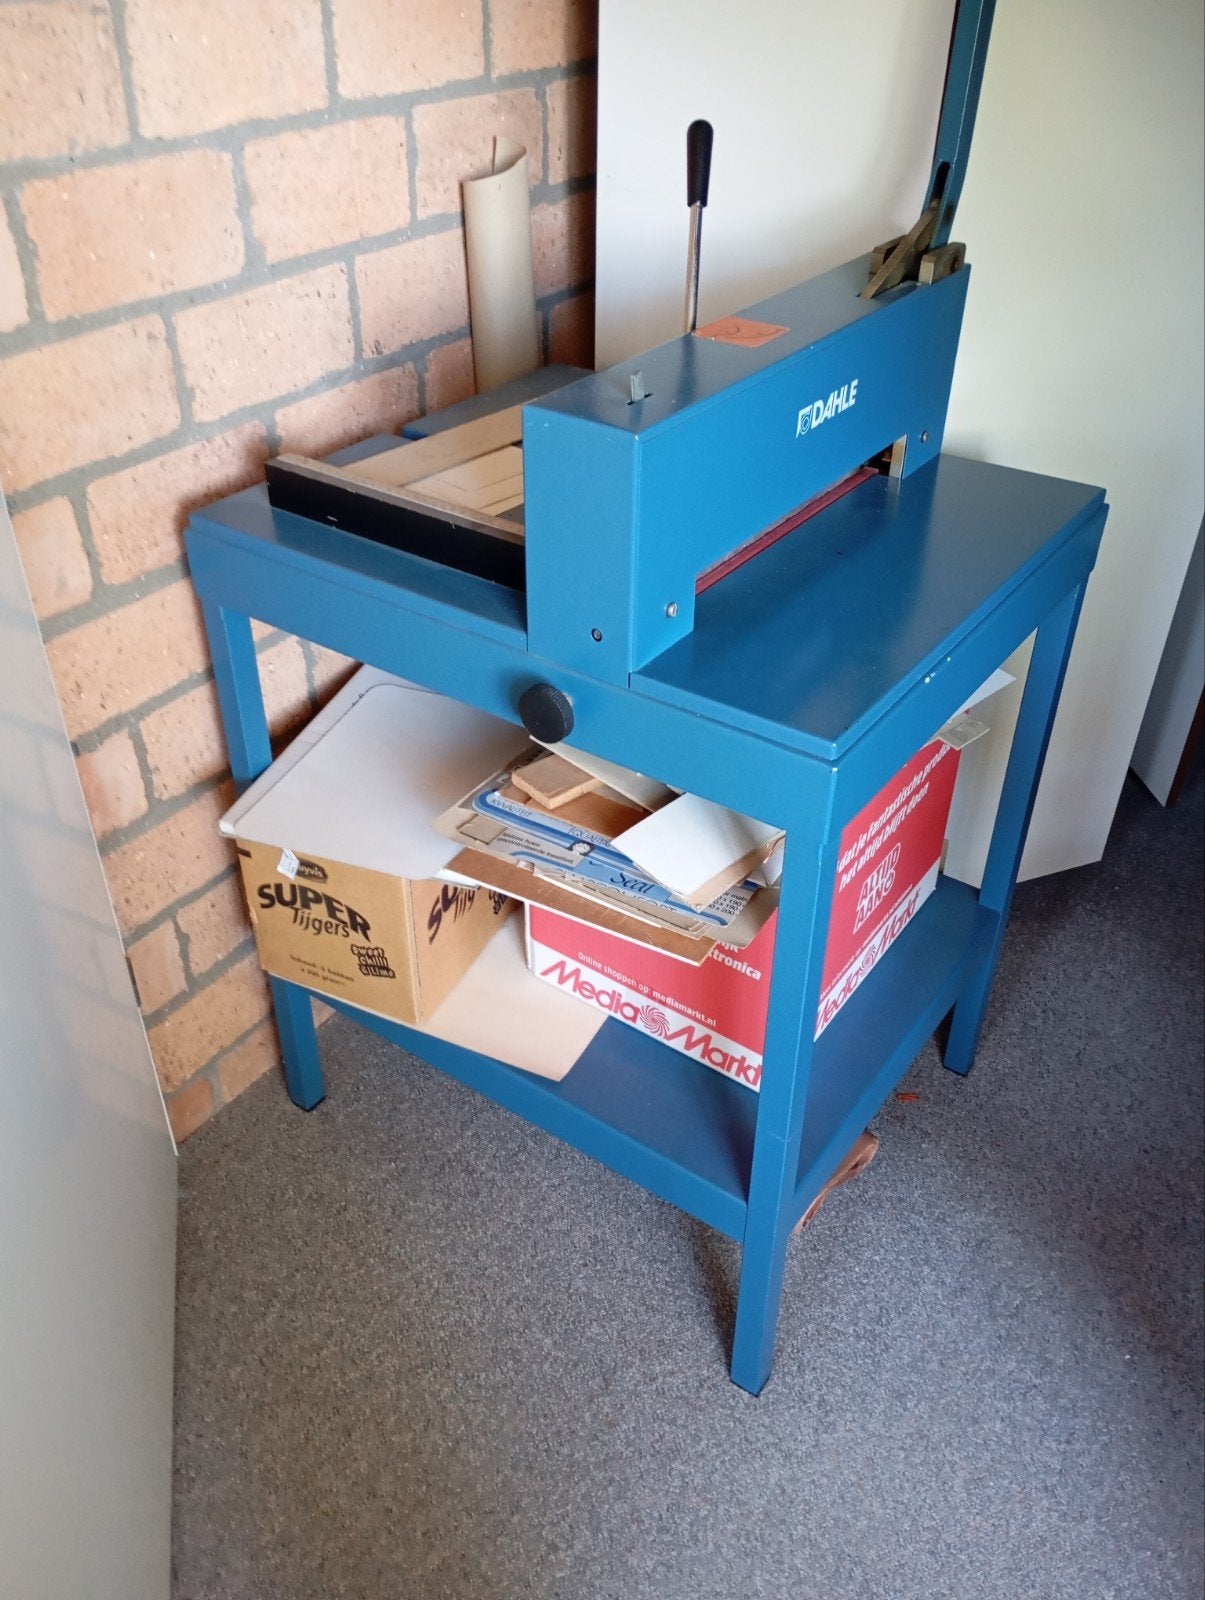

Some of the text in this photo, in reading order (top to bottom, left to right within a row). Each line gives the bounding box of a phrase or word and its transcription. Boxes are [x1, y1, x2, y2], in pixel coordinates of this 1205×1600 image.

[810, 378, 859, 430] DAHLE
[256, 882, 372, 943] SUPER
[289, 906, 351, 939] Tijgers
[578, 951, 717, 1027] Online shoppen op: mediamarkt.nl
[540, 960, 763, 1087] Media Markt
